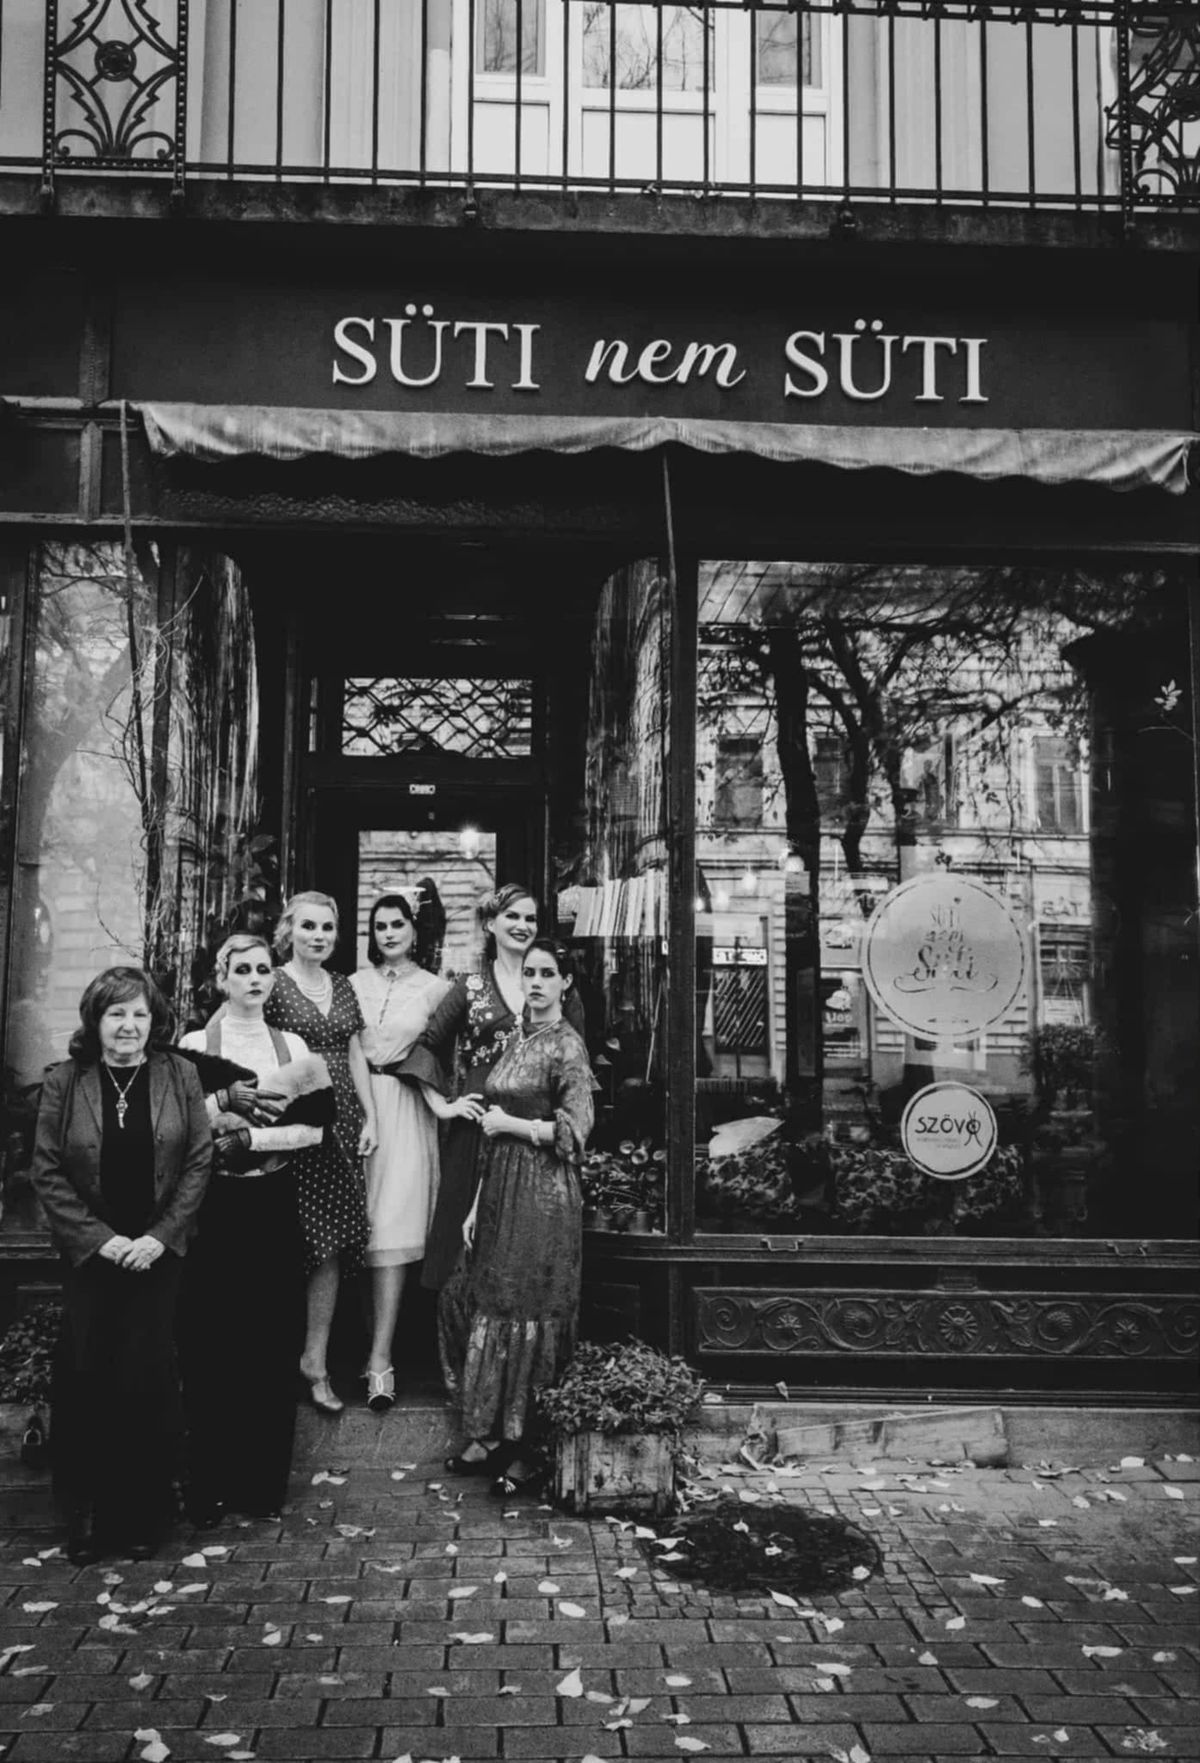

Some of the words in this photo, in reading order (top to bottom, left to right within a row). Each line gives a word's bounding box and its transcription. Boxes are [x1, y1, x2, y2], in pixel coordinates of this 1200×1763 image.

[332, 303, 541, 390] SÜTI
[584, 338, 747, 388] nem
[783, 318, 989, 402] SÜTI
